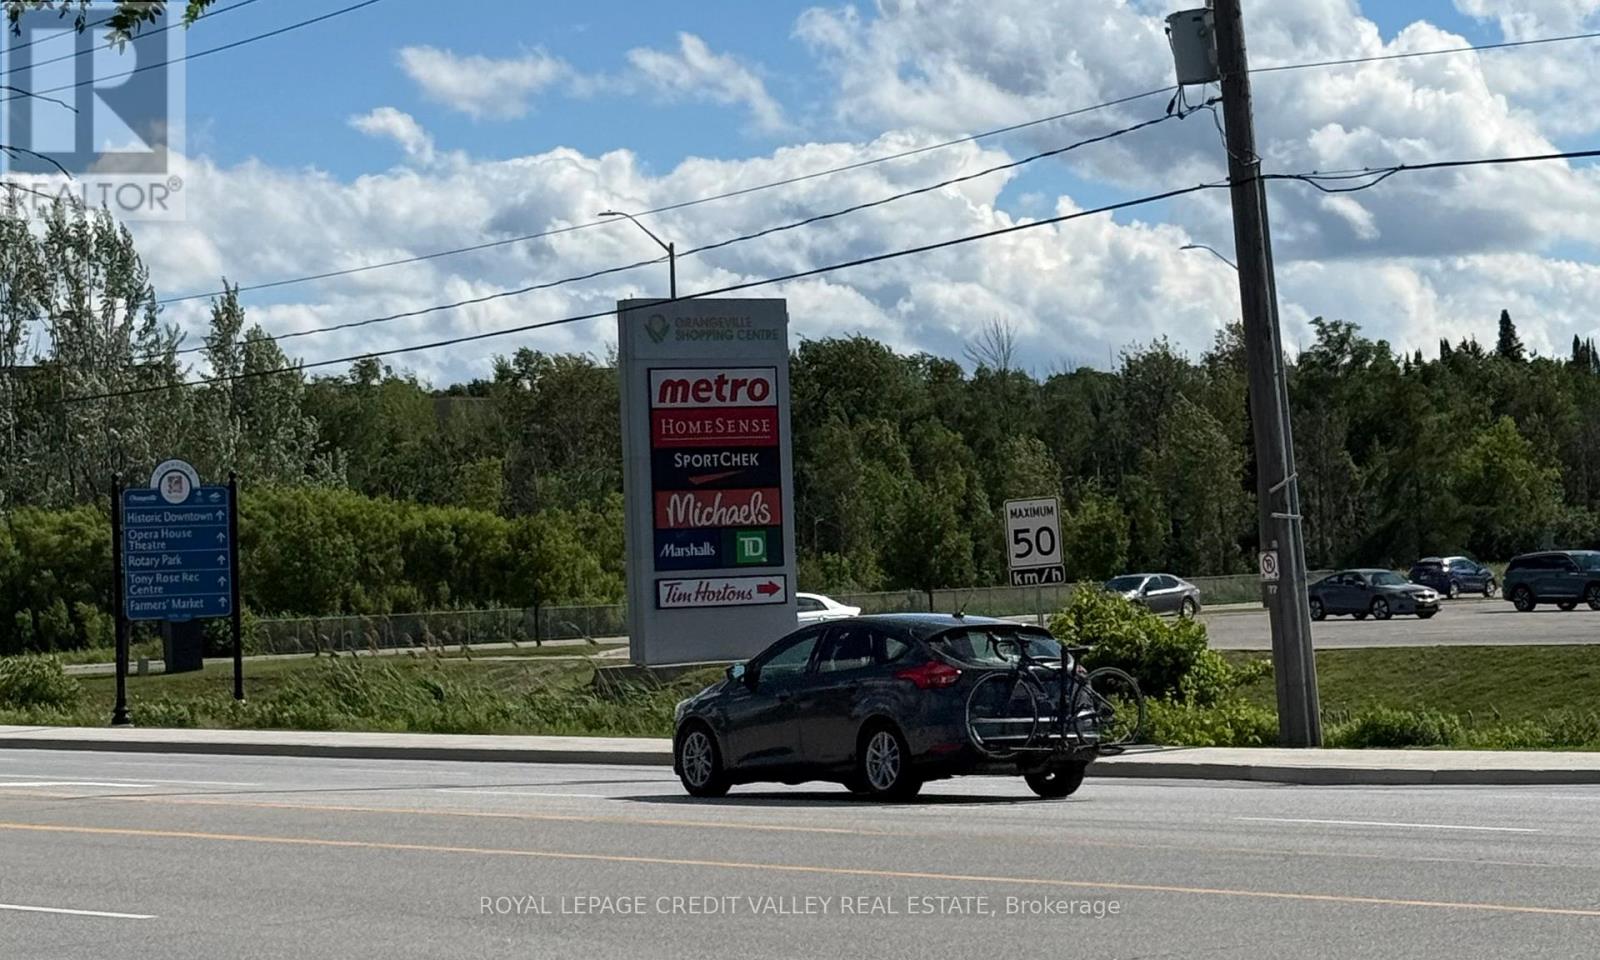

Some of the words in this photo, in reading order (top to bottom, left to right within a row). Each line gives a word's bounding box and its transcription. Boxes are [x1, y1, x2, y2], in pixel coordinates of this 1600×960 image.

[674, 316, 752, 328] ORANGEVILLE
[675, 329, 734, 341] SHOPPING
[737, 328, 779, 341] CENTRE
[658, 373, 770, 403] metro
[666, 491, 771, 527] Michaels
[1010, 505, 1054, 519] MAXIMUM
[127, 512, 162, 524] Historic
[164, 511, 213, 522] Downtown
[128, 530, 159, 541] Opera
[161, 529, 192, 539] House
[128, 540, 166, 550] Theatre
[660, 542, 716, 557] Marshalls
[739, 537, 764, 556] TD
[1013, 526, 1056, 559] 50
[128, 555, 160, 568] Rotary
[162, 554, 182, 566] Park
[129, 574, 153, 585] Tony
[156, 573, 180, 583] Rose
[182, 573, 200, 582] Rec
[1013, 568, 1062, 585] km/h
[129, 585, 164, 595] Centre
[664, 581, 692, 604] Tim
[694, 580, 753, 602] Hortons
[130, 599, 169, 611] Farmers'
[172, 598, 204, 609] Market
